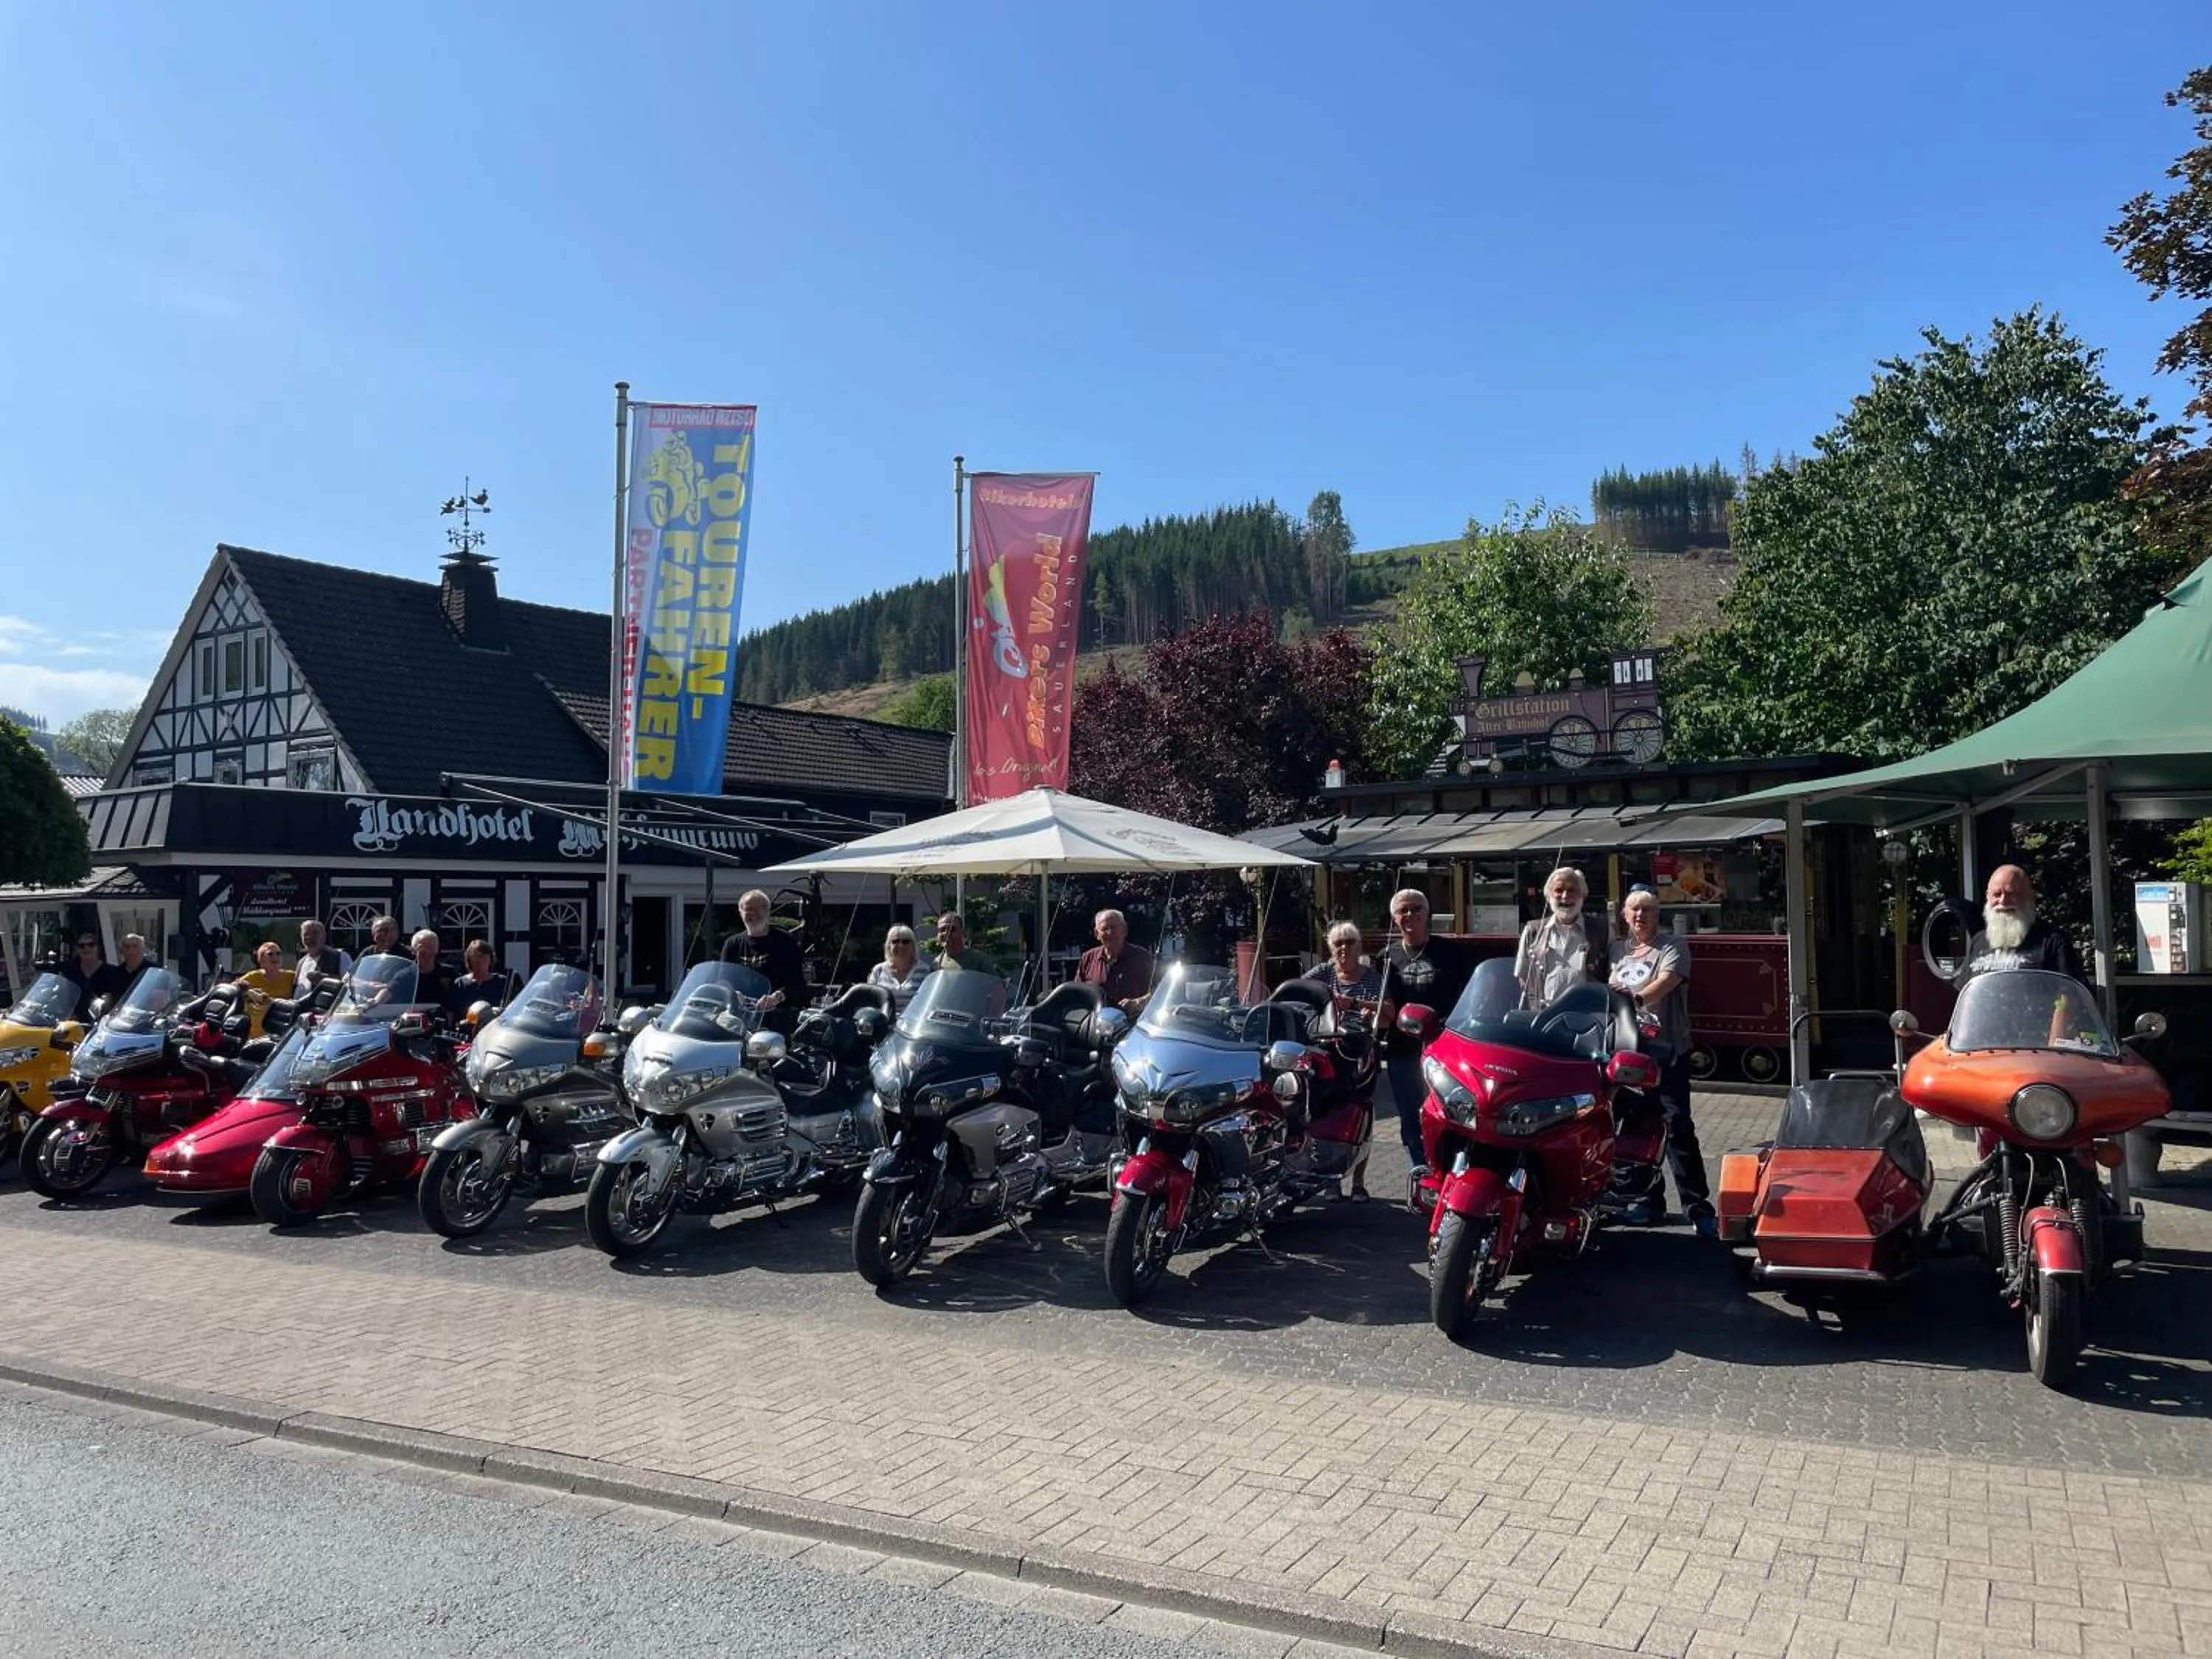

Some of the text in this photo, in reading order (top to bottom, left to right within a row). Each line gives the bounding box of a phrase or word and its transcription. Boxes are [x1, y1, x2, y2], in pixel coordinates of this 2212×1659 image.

[653, 408, 712, 425] MOTORRAD
[687, 434, 751, 720] TOUREN-
[1028, 532, 1062, 634] World
[634, 530, 699, 779] FAHRER
[1052, 554, 1077, 733] SAUERLAND
[1475, 700, 1570, 719] Grillstation
[345, 798, 535, 852] Landhotel
